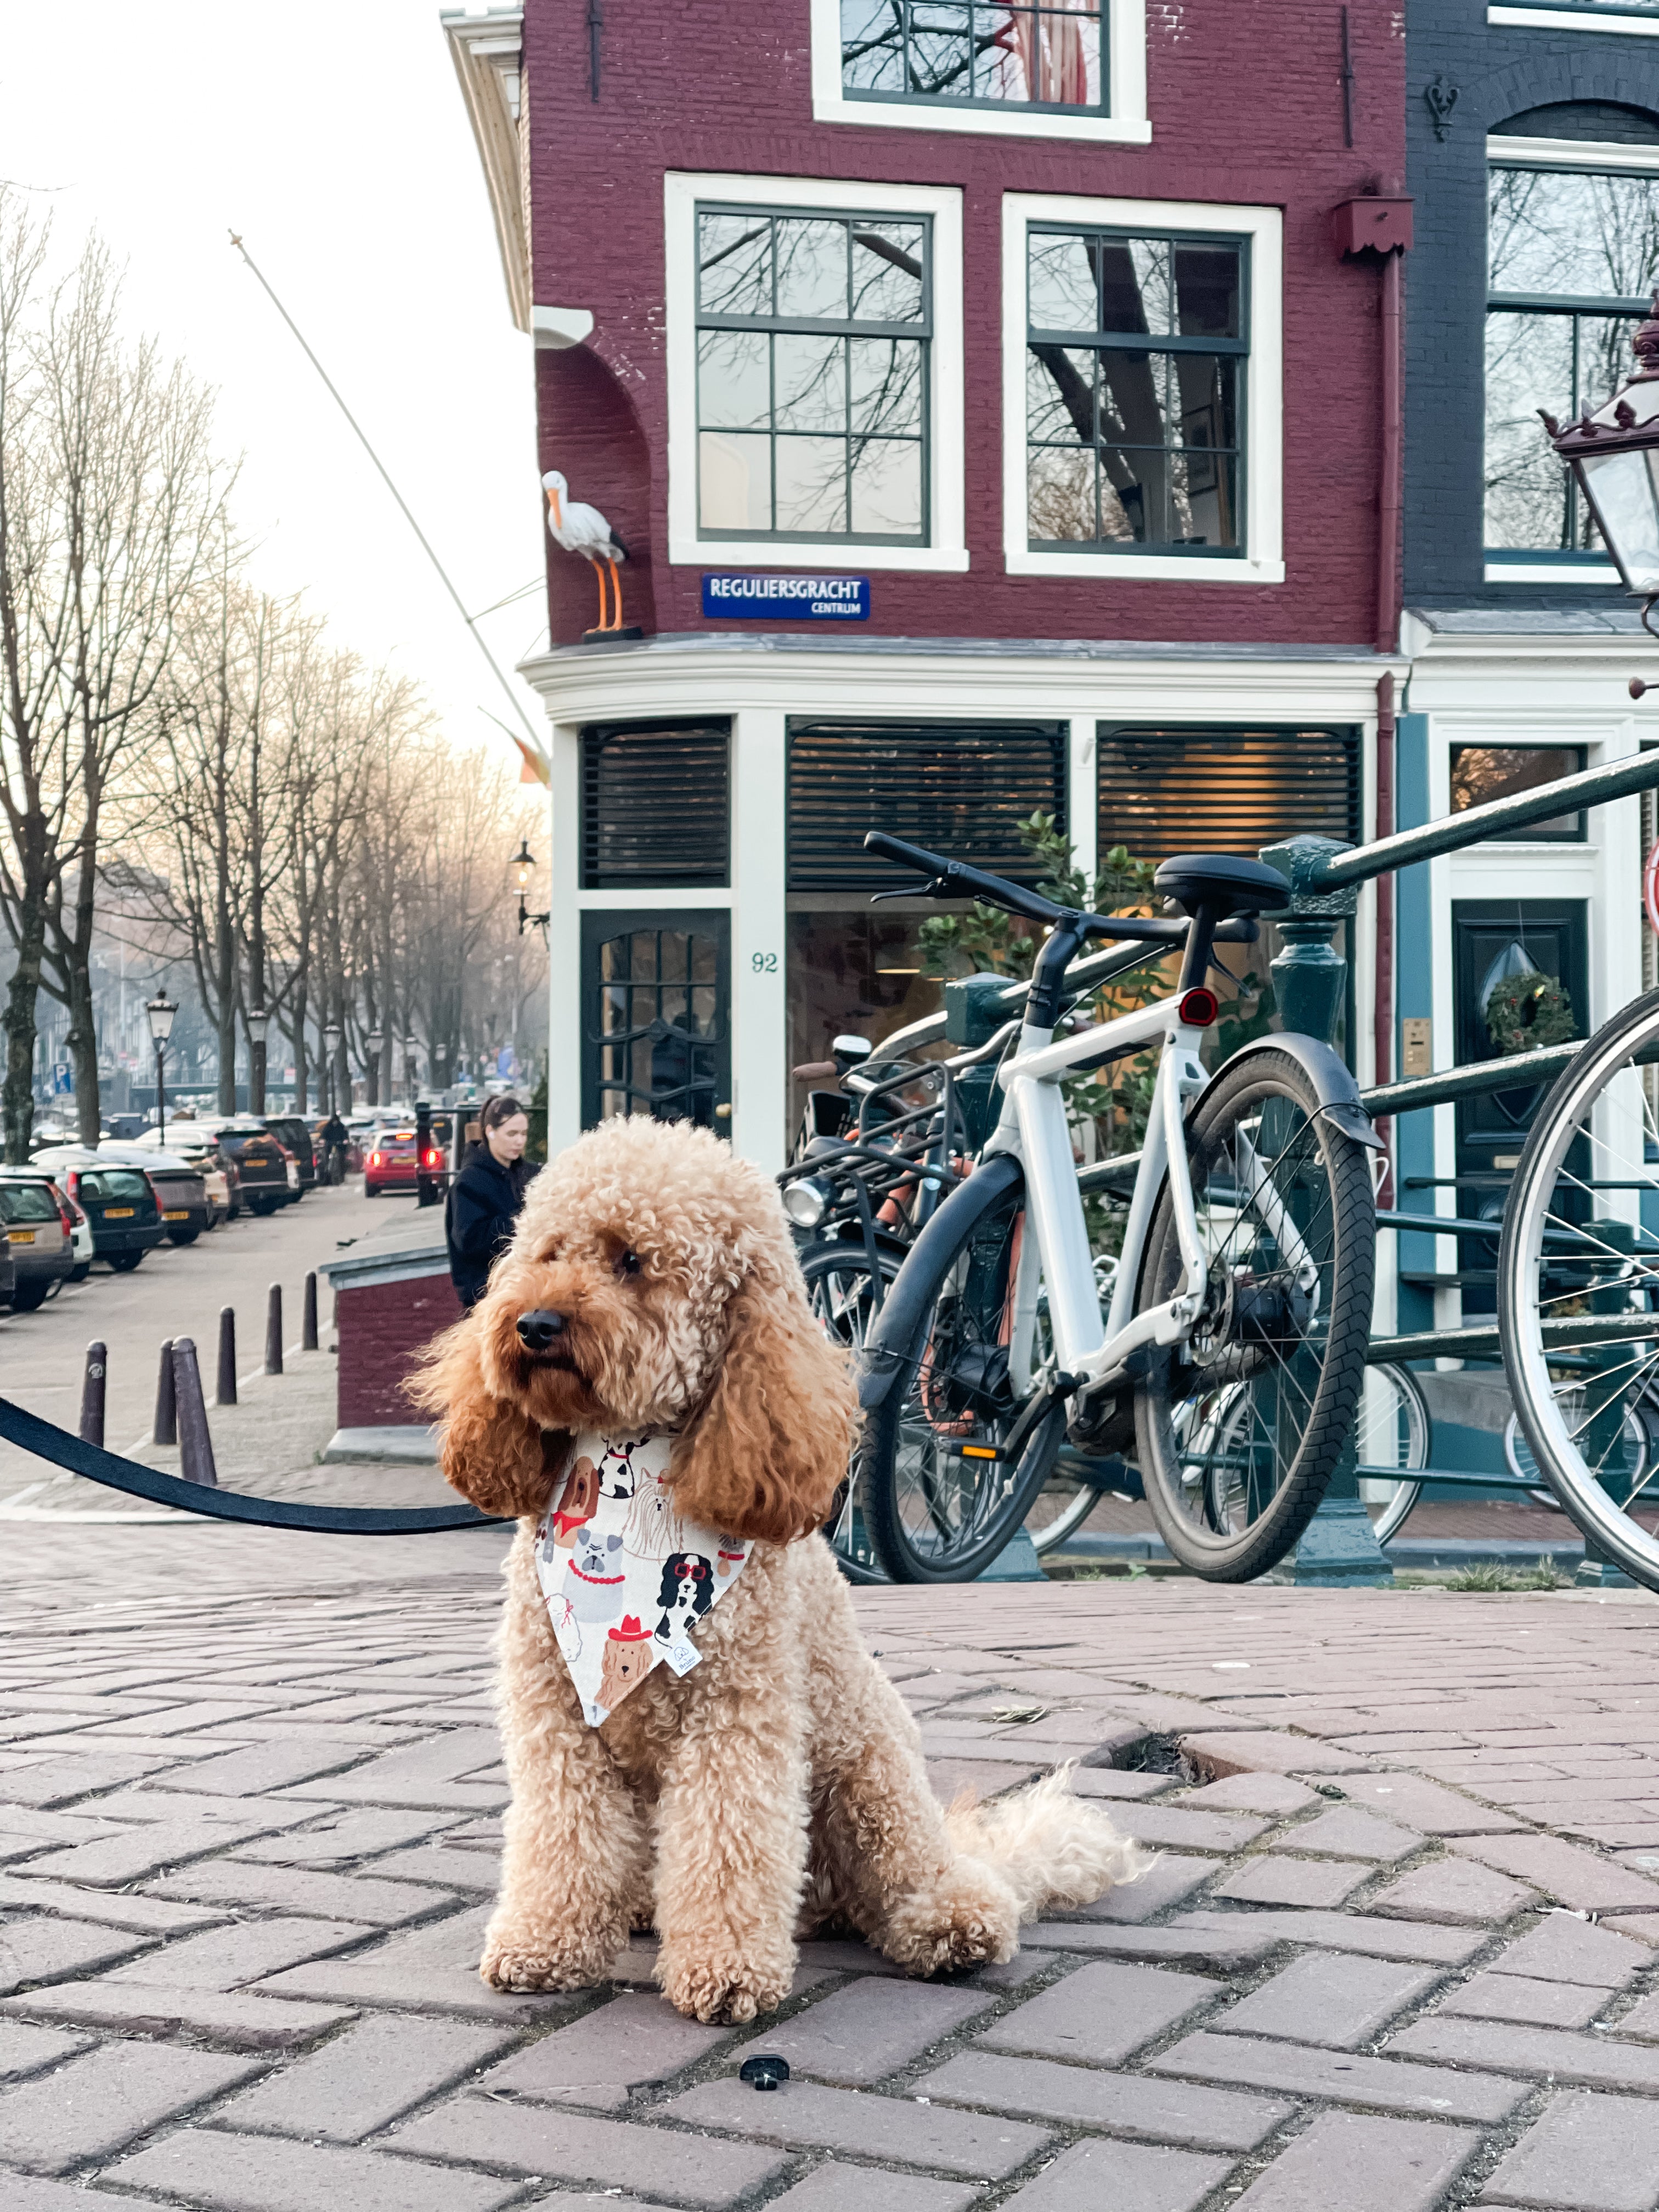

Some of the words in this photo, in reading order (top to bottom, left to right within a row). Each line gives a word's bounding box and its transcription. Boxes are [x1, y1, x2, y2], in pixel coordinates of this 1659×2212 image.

[710, 578, 861, 599] REGULIERSGRACHT
[811, 602, 861, 613] CENTRUM
[752, 952, 778, 973] 92
[56, 1065, 66, 1081] P
[679, 1656, 695, 1670] Bruno
